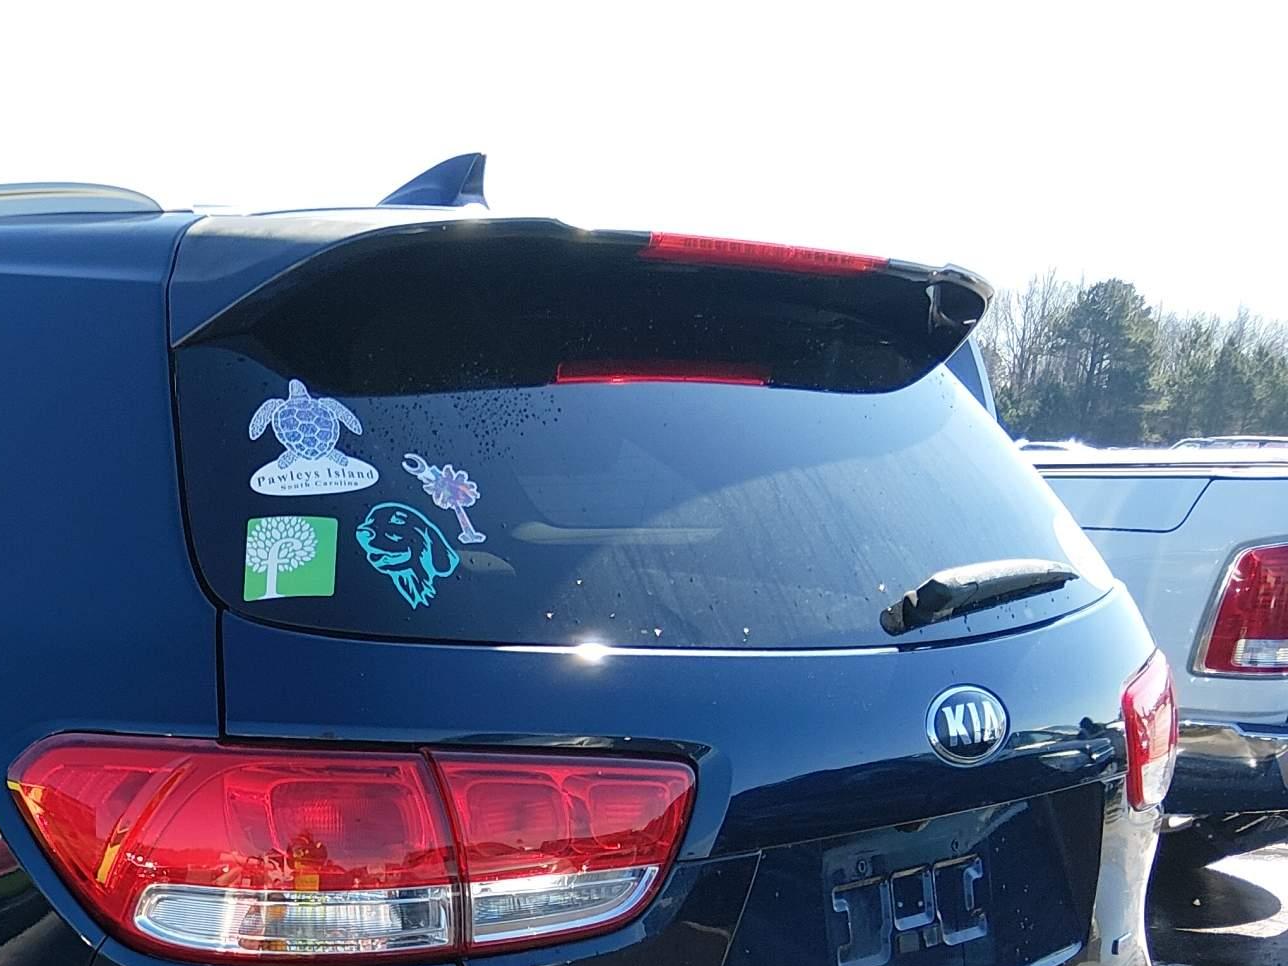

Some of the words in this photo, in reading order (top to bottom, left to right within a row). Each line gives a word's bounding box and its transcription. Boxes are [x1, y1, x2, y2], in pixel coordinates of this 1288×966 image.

[257, 469, 320, 487] Pawleys
[327, 467, 374, 479] Island
[281, 482, 310, 490] South
[942, 701, 1000, 747] KIA
